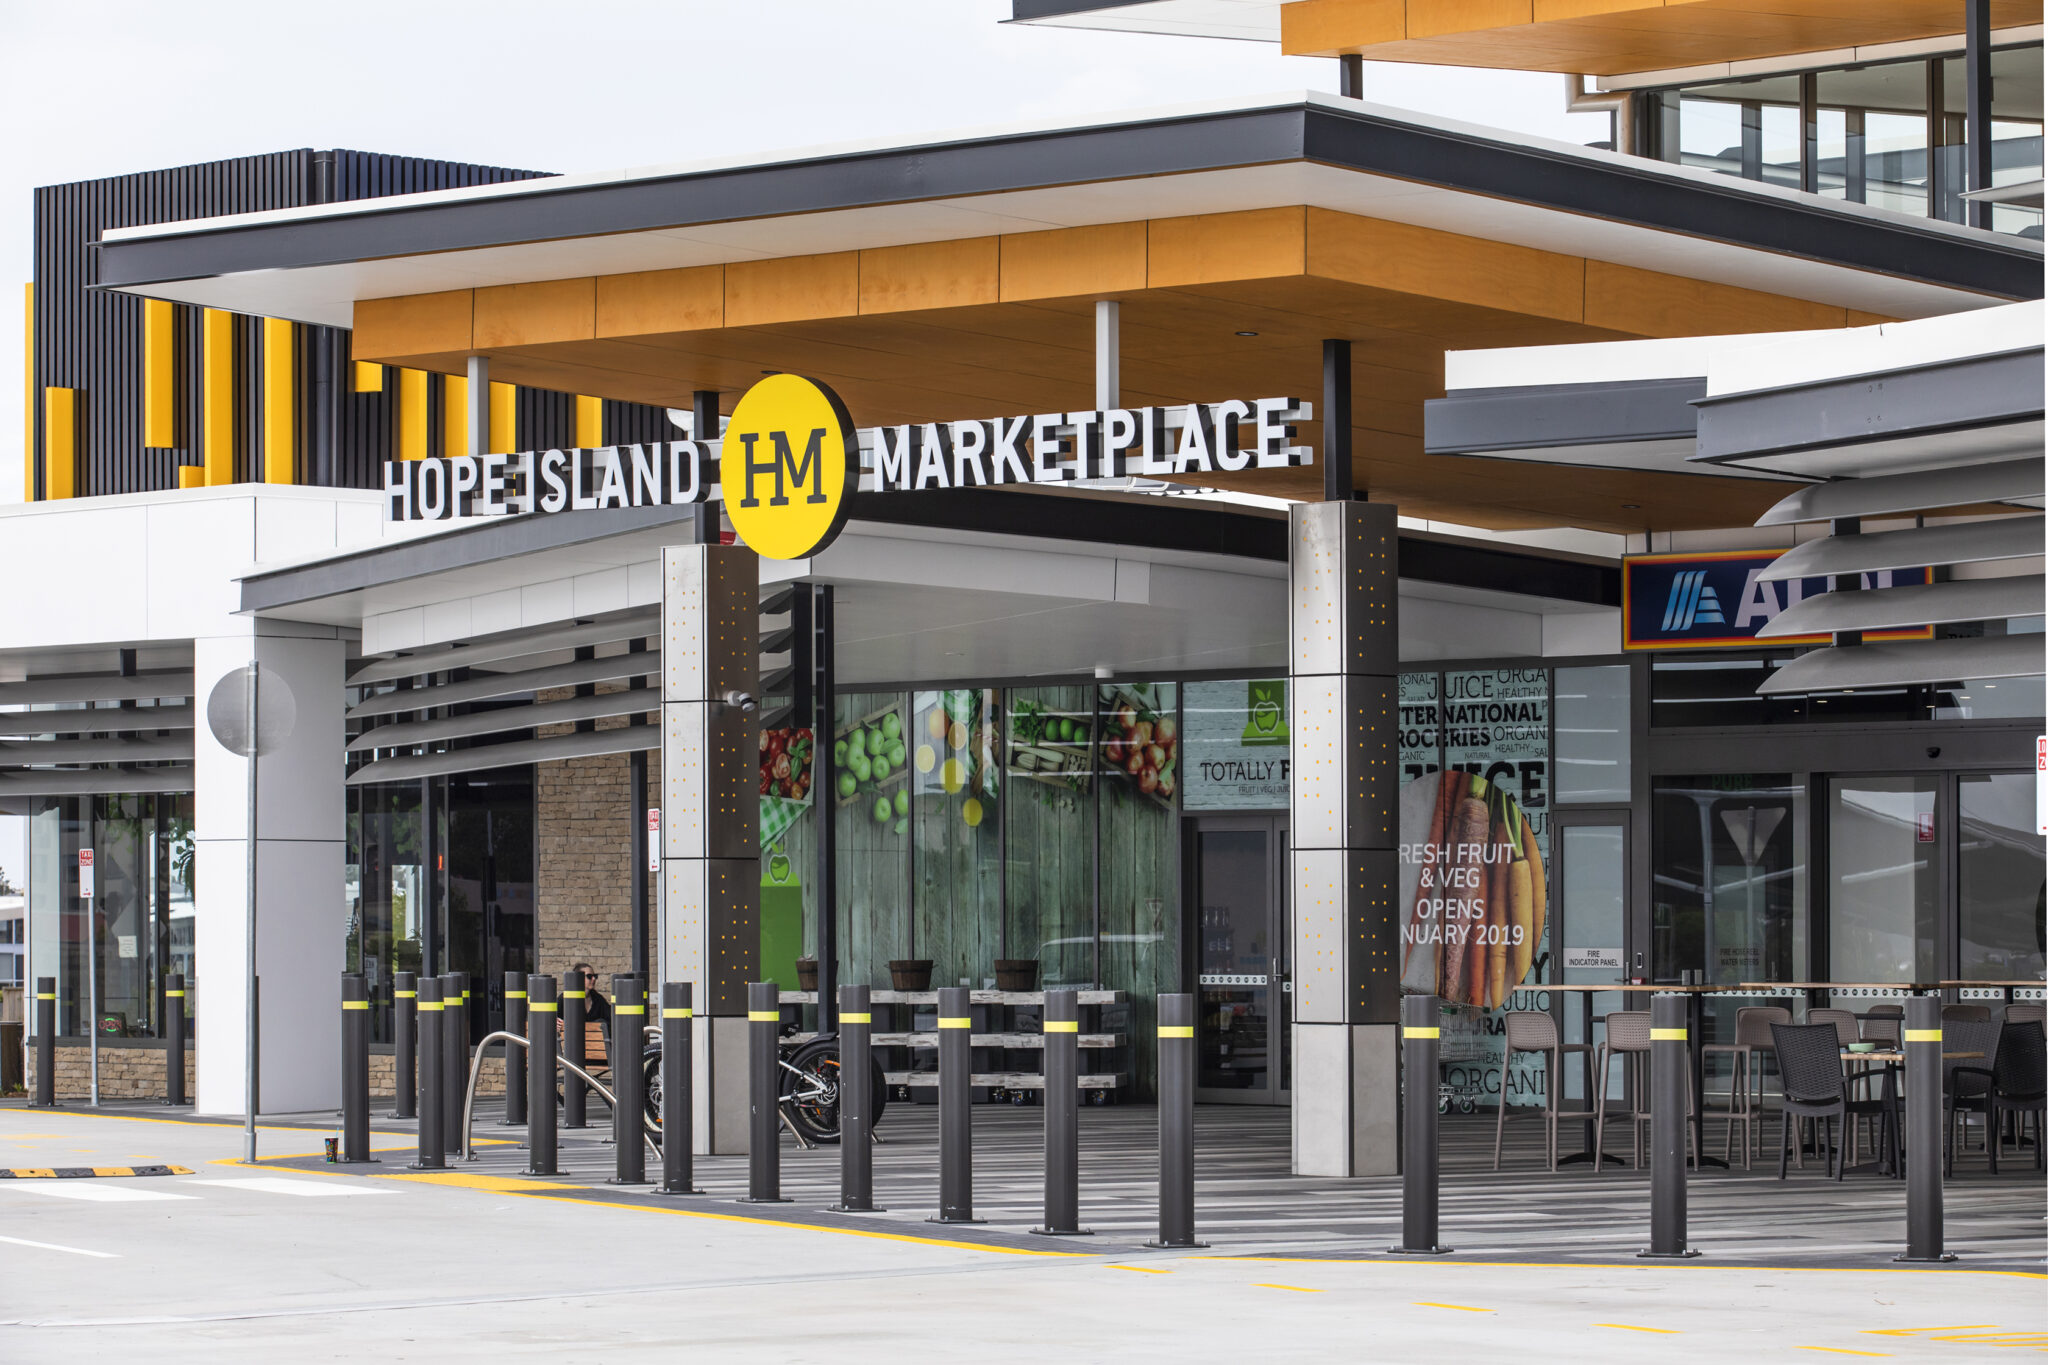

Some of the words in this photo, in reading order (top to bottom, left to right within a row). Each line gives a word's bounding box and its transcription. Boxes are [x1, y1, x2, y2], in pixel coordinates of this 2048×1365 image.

[384, 453, 510, 521] HOPE
[526, 440, 703, 513] ISLAND
[874, 397, 1292, 492] MARKETPLACE
[740, 428, 827, 508] HM
[1427, 675, 1494, 700] JUICE
[1497, 687, 1542, 699] HEALTHY
[1399, 702, 1543, 725] TERNATIONAL
[1200, 761, 1275, 781] TOTALLY
[1238, 785, 1256, 793] FRUIT
[1261, 785, 1273, 793] VEG
[1399, 843, 1450, 864] RESH
[1457, 843, 1516, 864] FRUIT
[1420, 867, 1435, 888] &
[1438, 867, 1480, 888] VEG
[1416, 898, 1485, 919] OPENS
[1400, 924, 1472, 945] NUARY
[1475, 924, 1524, 946] 2019
[1587, 950, 1601, 958] FIRE
[1600, 959, 1619, 967] PANEL
[1476, 1052, 1526, 1064] HEALHY
